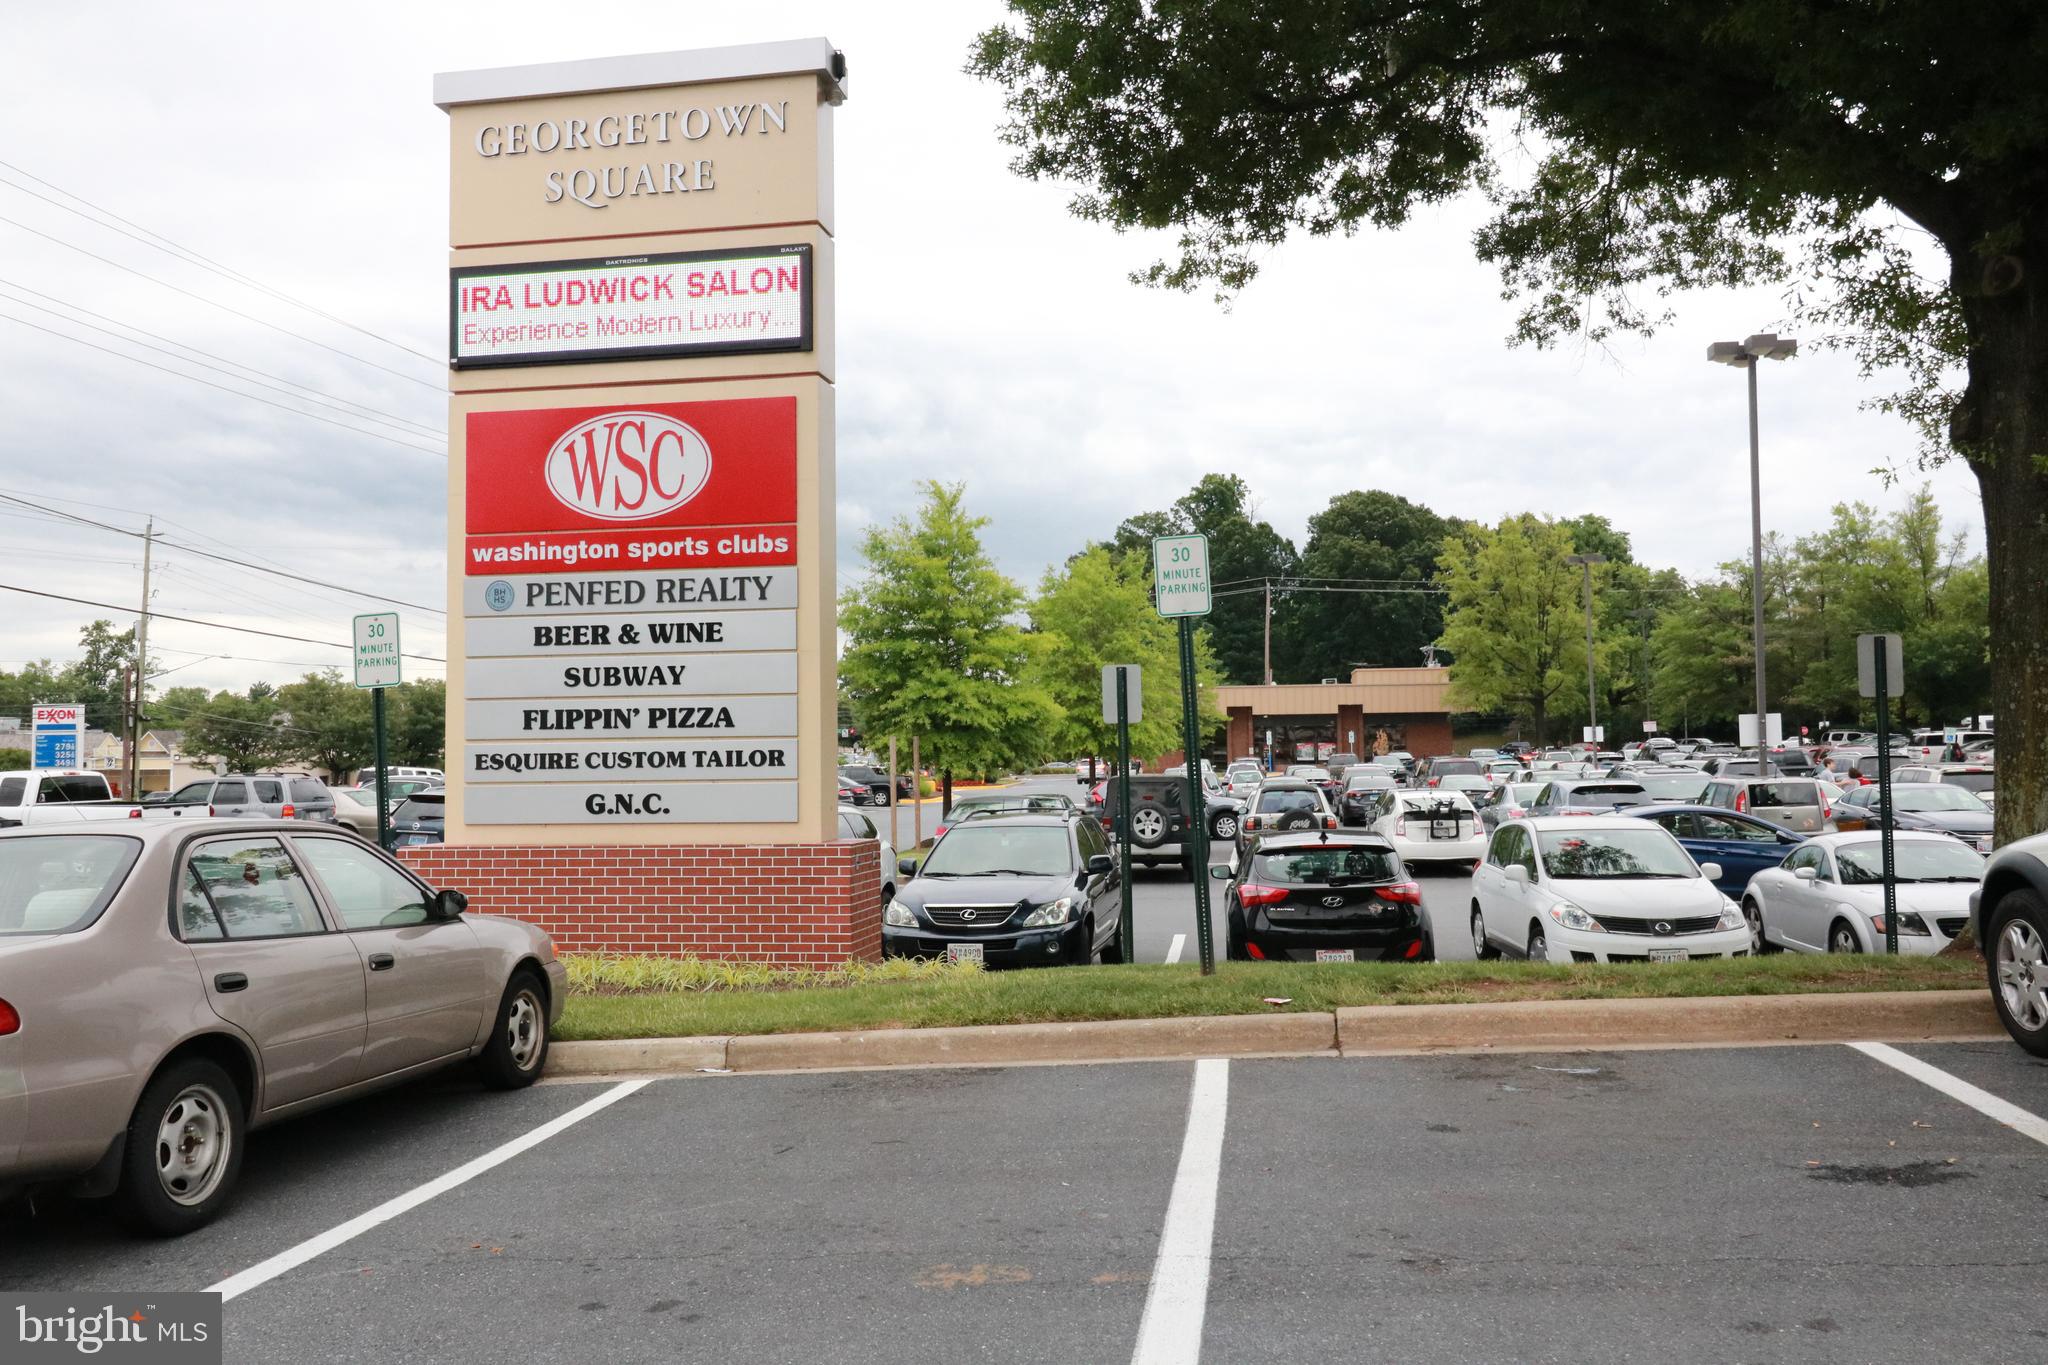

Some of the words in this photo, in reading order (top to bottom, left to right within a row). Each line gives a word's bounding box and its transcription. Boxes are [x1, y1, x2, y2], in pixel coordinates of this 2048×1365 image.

[475, 100, 789, 157] GEORGETOWN
[545, 159, 716, 209] SQUARE
[605, 257, 648, 265] DAKTRONICS
[461, 284, 514, 313] IRA
[524, 273, 674, 309] LUDWICK
[687, 265, 799, 298] SALON
[464, 321, 588, 347] Experience
[596, 312, 682, 337] Modern
[563, 420, 686, 511] WSC
[472, 541, 620, 564] washington
[628, 537, 709, 561] sports
[717, 534, 789, 556] clubs
[1171, 547, 1190, 563] 30
[1163, 568, 1201, 580] MINUTE
[526, 580, 646, 608] PENFED
[655, 575, 774, 603] REALTY
[1160, 583, 1206, 594] PARKING
[368, 624, 385, 638] 30
[533, 625, 610, 647] BEER
[618, 623, 640, 645] &
[648, 621, 724, 644] WINE
[360, 643, 393, 655] MINUTE
[358, 657, 397, 668] PARKING
[563, 665, 686, 688] SUBWAY
[37, 708, 76, 723] EXXON
[647, 706, 736, 729] PIZZA
[474, 753, 579, 771] ESQUIRE
[584, 751, 686, 770] CUSTOM
[692, 749, 786, 768] TAILOR
[585, 793, 670, 816] G.N.C.
